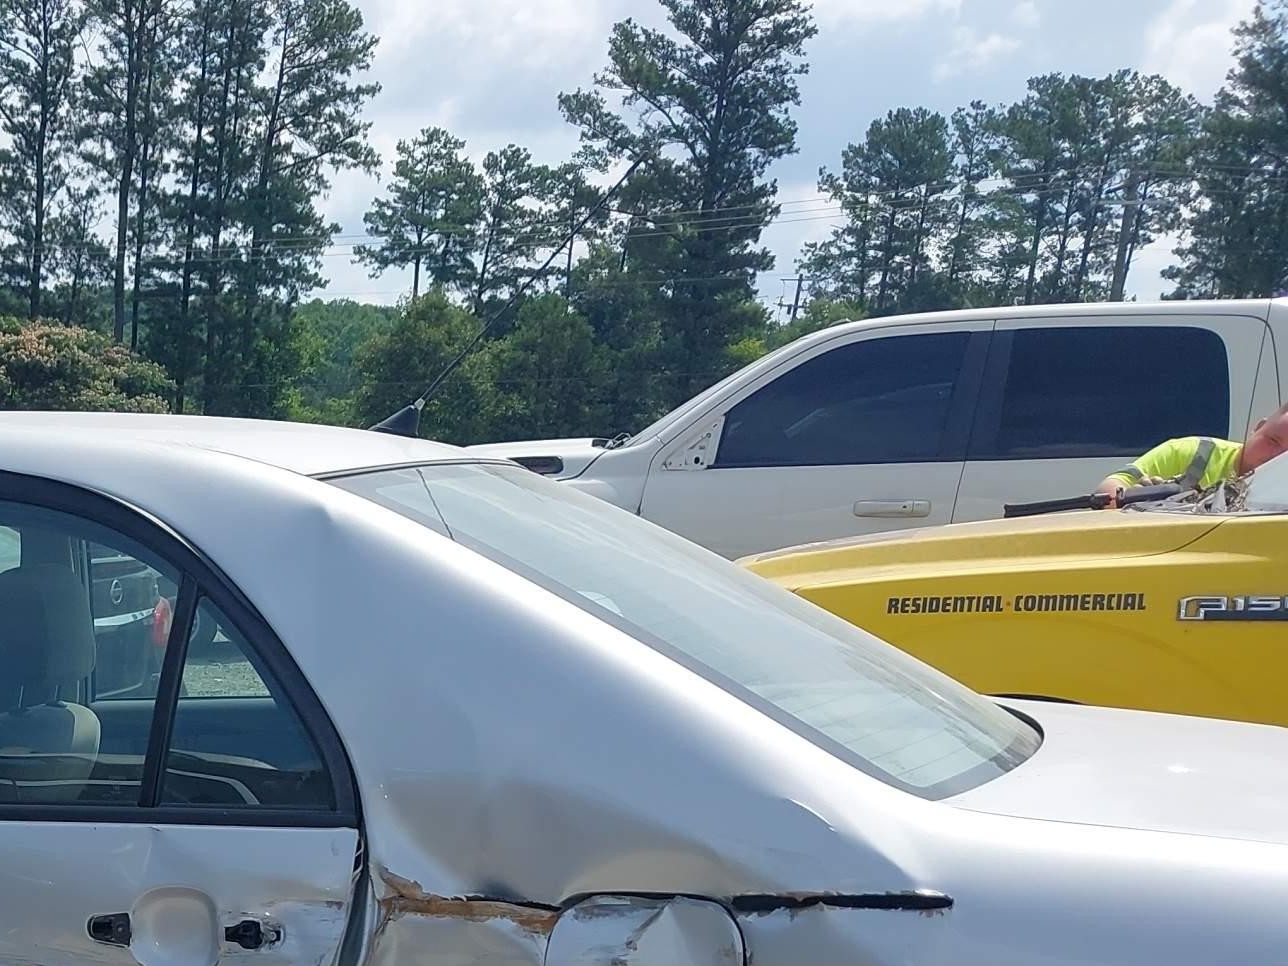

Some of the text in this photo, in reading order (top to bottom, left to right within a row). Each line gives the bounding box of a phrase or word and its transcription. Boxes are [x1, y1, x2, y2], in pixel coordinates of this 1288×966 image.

[887, 593, 1147, 614] RESIDENTIAL COMMERCIAL
[1177, 595, 1288, 620] F15
